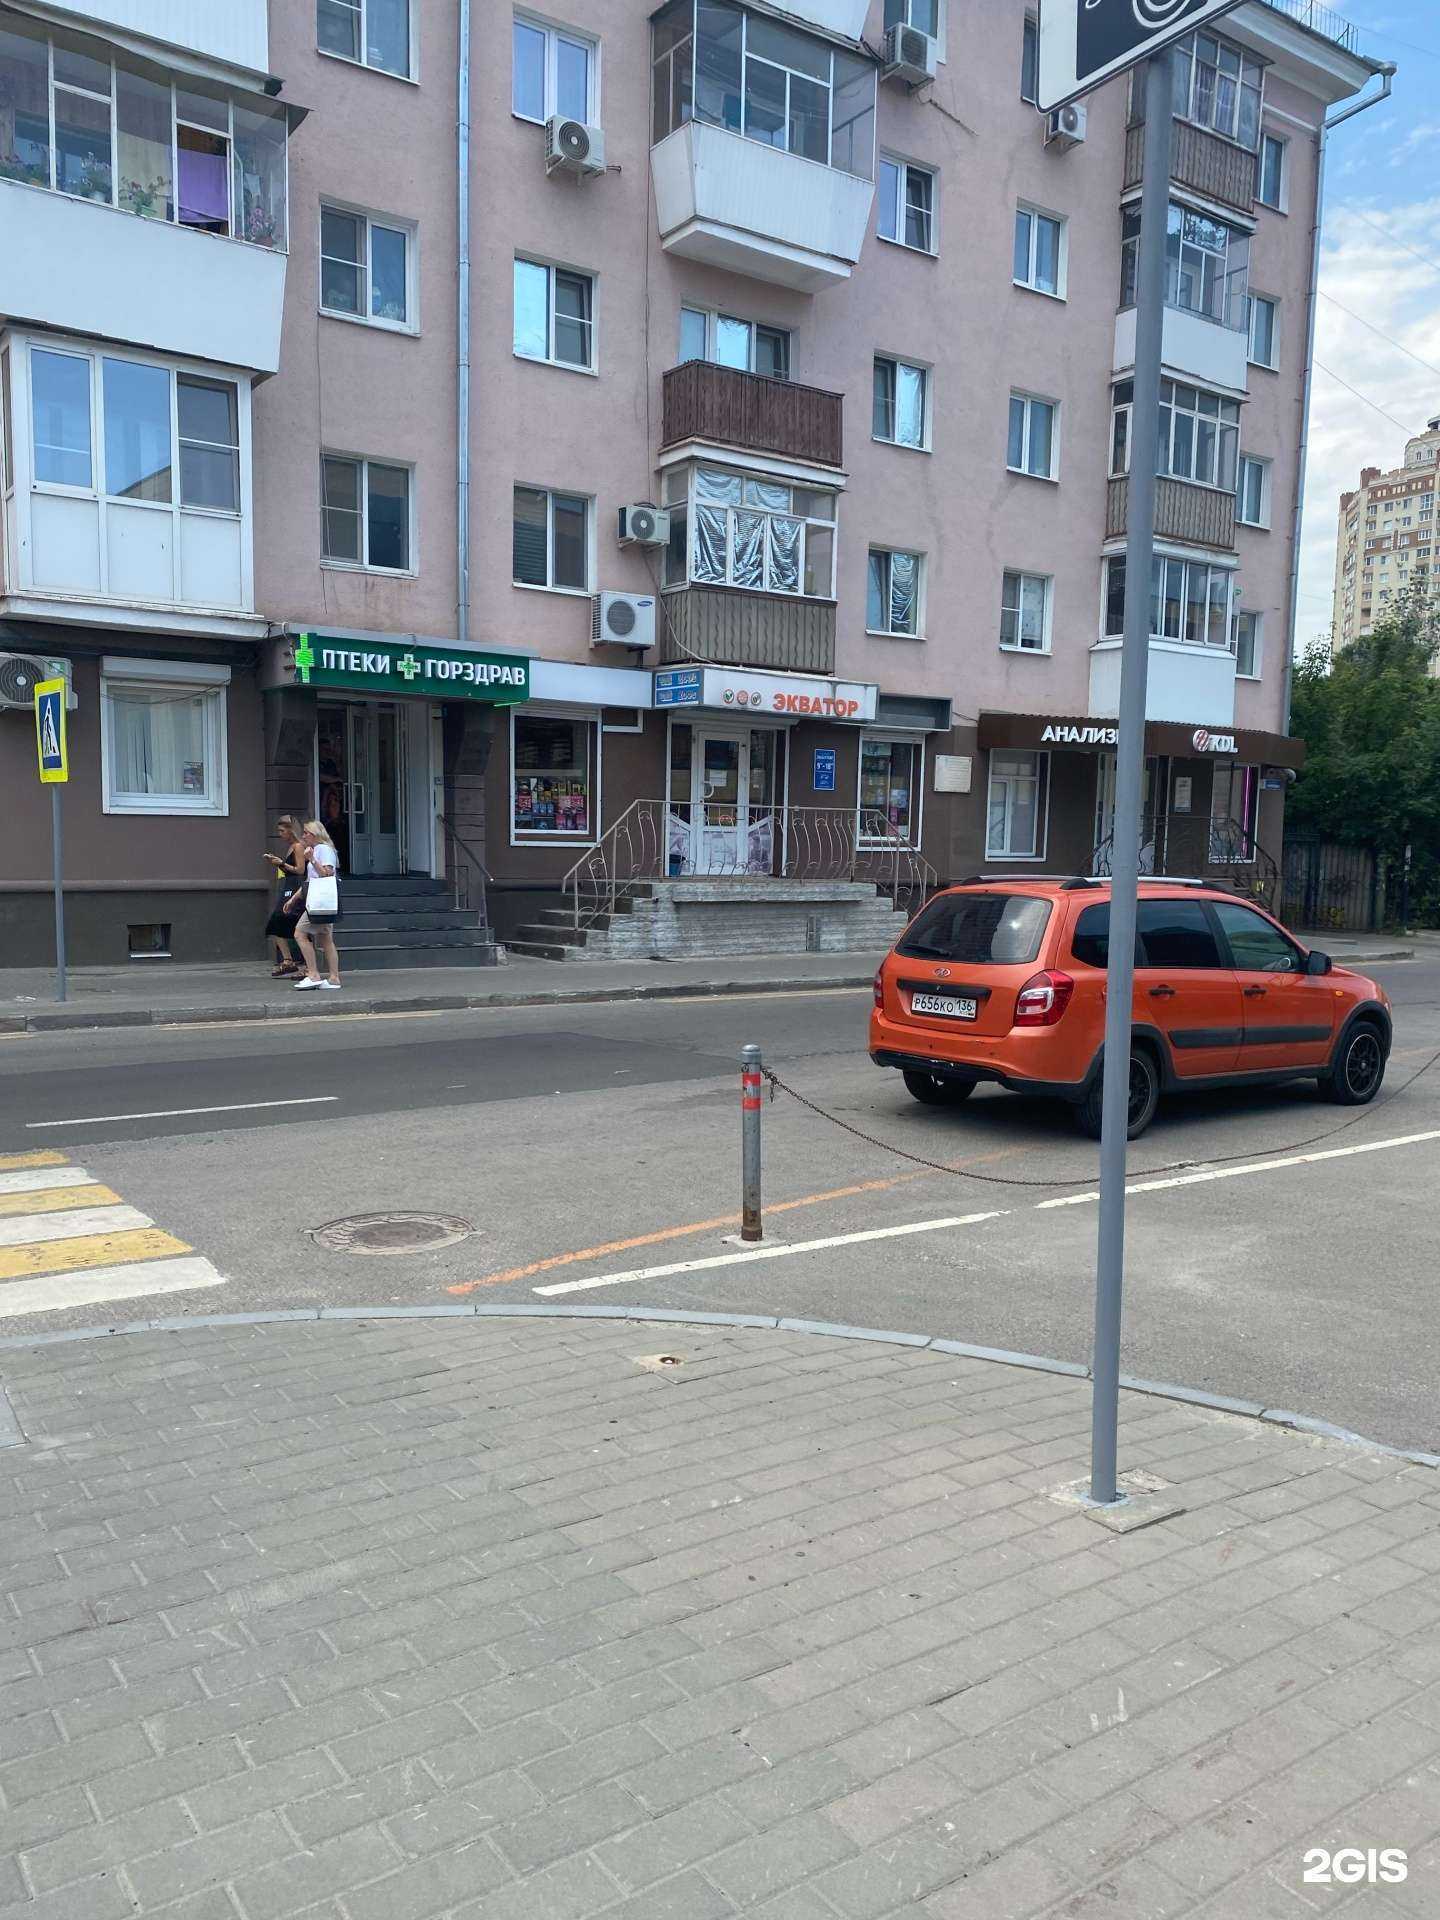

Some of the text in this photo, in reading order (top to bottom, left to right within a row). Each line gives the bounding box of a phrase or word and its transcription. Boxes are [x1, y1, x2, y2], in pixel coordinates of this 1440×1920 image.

[321, 649, 526, 686] ПТЕКИ ГОРЗДРАВ
[773, 693, 859, 717] ЭКВАТОР
[1041, 725, 1119, 745] АНАЛИЗ
[956, 1000, 973, 1011] 136
